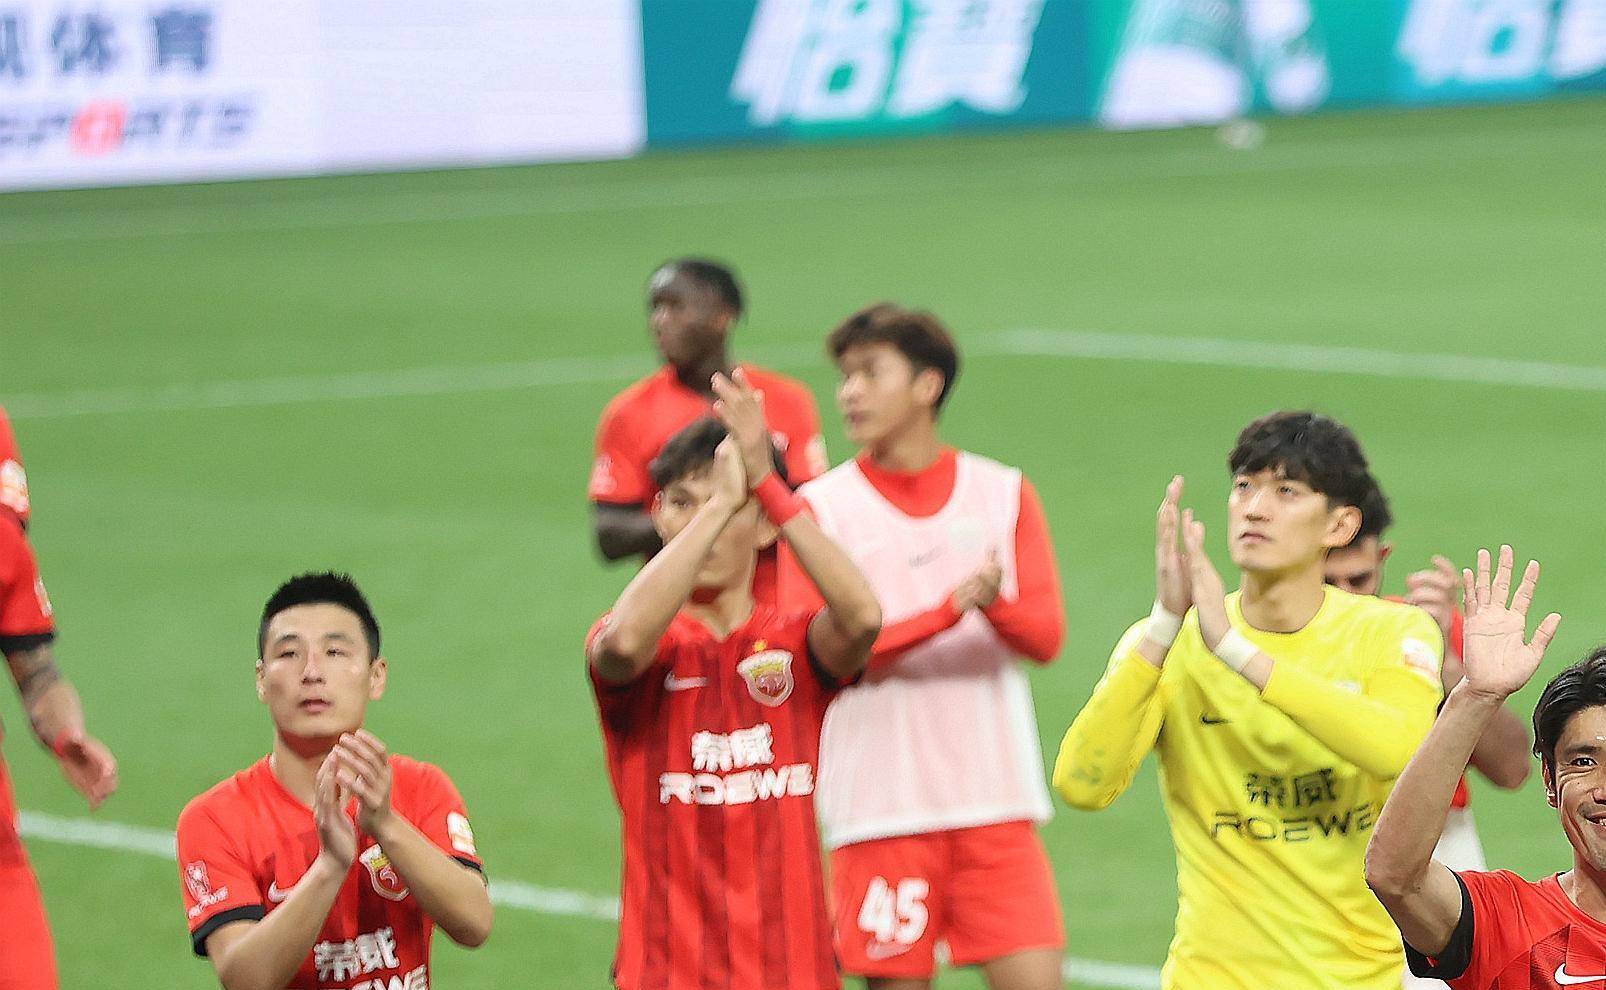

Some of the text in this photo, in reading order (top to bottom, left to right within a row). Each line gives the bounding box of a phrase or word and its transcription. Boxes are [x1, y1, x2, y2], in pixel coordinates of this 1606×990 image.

[658, 763, 814, 805] ROEWE
[1211, 804, 1373, 842] ROEWE
[857, 876, 929, 946] 45
